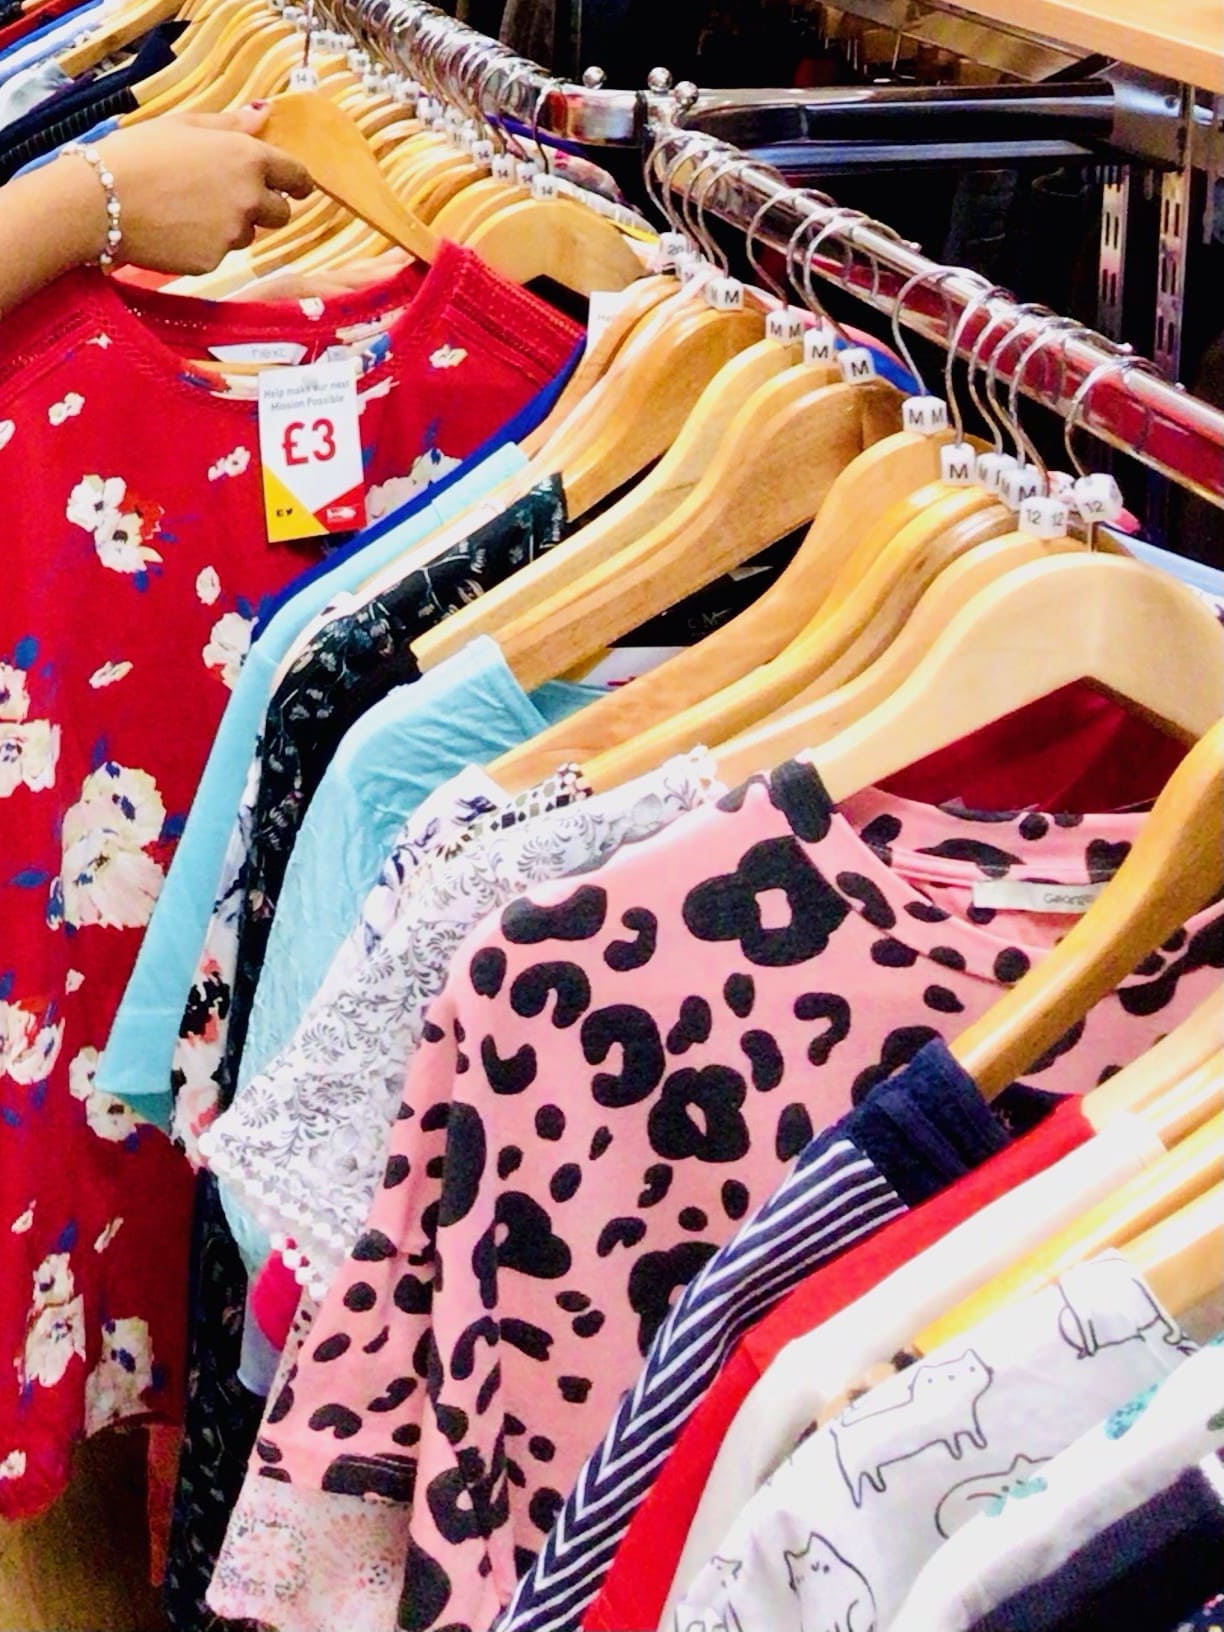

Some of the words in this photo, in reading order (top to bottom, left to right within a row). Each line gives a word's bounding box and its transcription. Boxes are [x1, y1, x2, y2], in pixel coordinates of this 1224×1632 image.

[725, 289, 740, 304] M
[770, 321, 783, 333] M
[812, 345, 829, 358] M
[851, 360, 870, 376] M
[909, 409, 924, 425] M
[932, 408, 944, 424] M
[282, 418, 336, 466] £3
[950, 464, 968, 479] M
[1085, 500, 1104, 513] 12
[1027, 510, 1041, 525] 12
